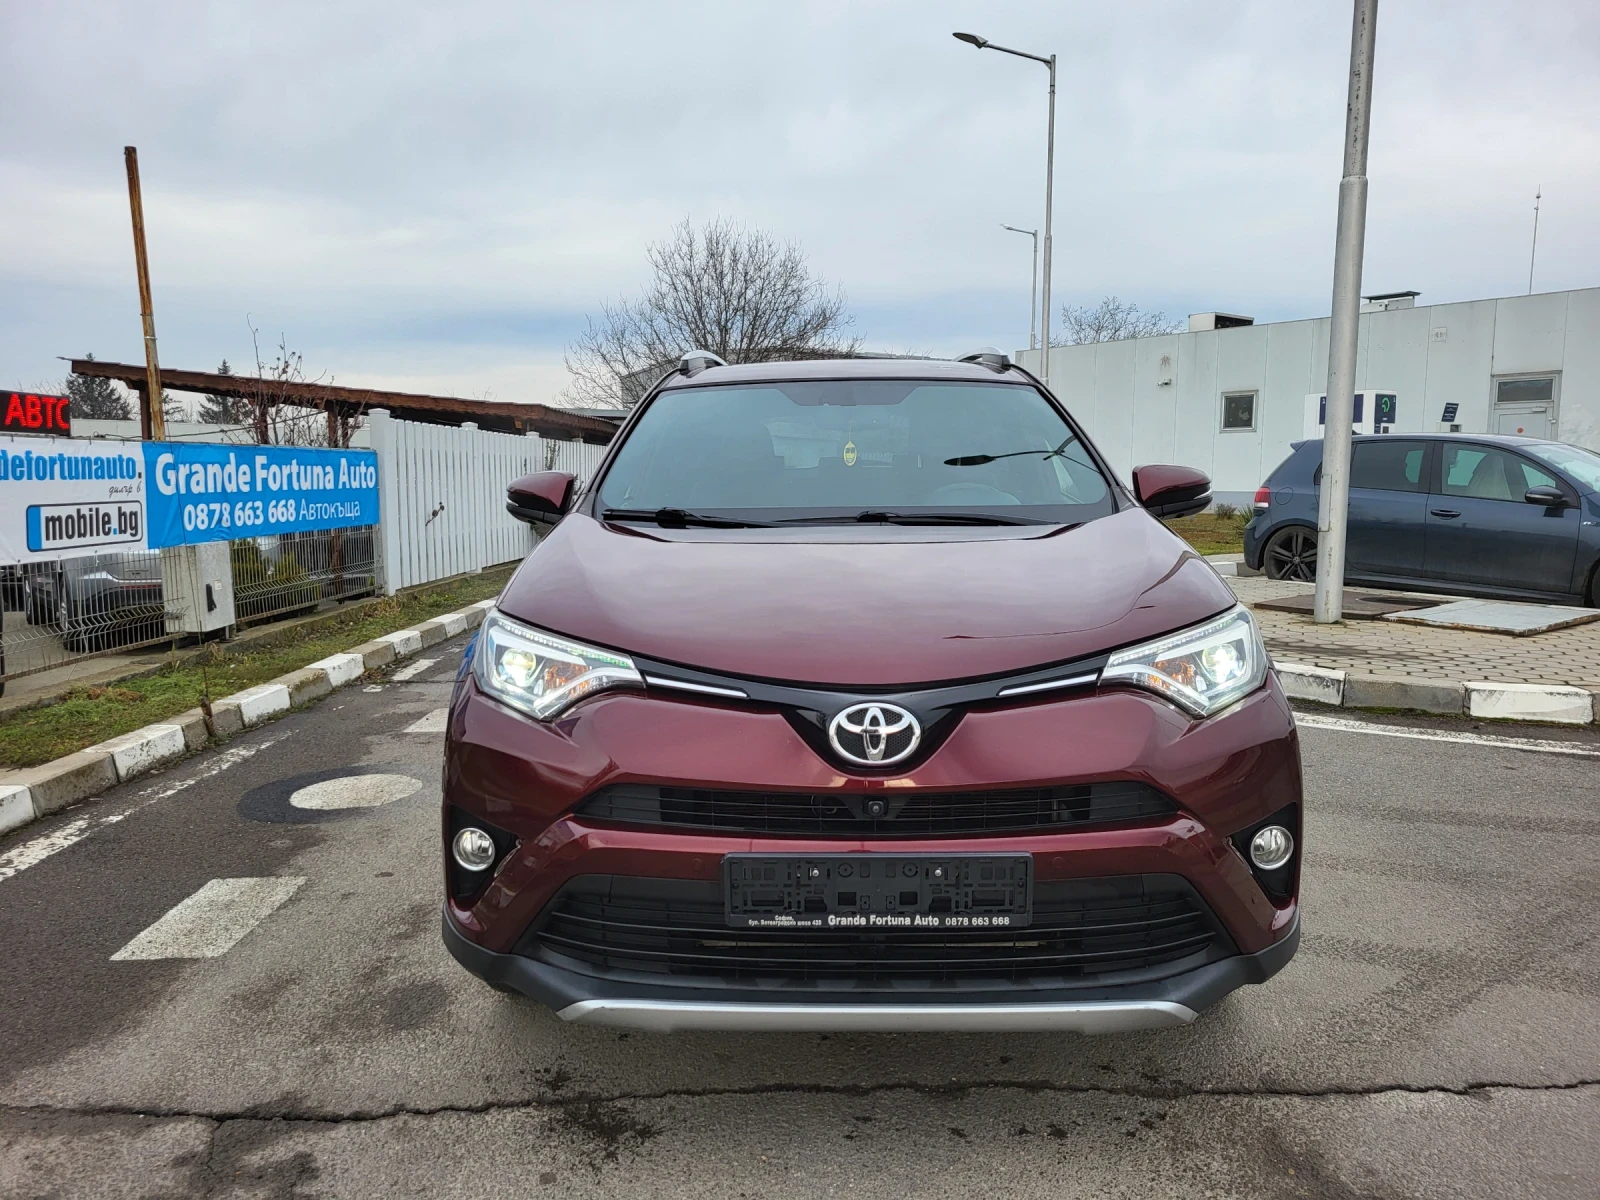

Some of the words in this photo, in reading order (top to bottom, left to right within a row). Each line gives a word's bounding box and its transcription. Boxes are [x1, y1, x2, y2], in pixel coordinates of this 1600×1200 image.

[155, 452, 251, 496] Grande
[255, 455, 334, 492] Fortuna
[338, 457, 376, 489] Auto
[45, 506, 139, 541] mobile.bg
[183, 502, 231, 532] 0878
[234, 500, 264, 527] 663
[268, 499, 297, 523] 668
[299, 500, 361, 521] Автокъща
[827, 915, 867, 926] Grande
[870, 914, 911, 926] Fortuna
[914, 915, 940, 926] Auto
[945, 917, 969, 926] 0878
[971, 917, 990, 926] 663
[992, 916, 1010, 925] 668
